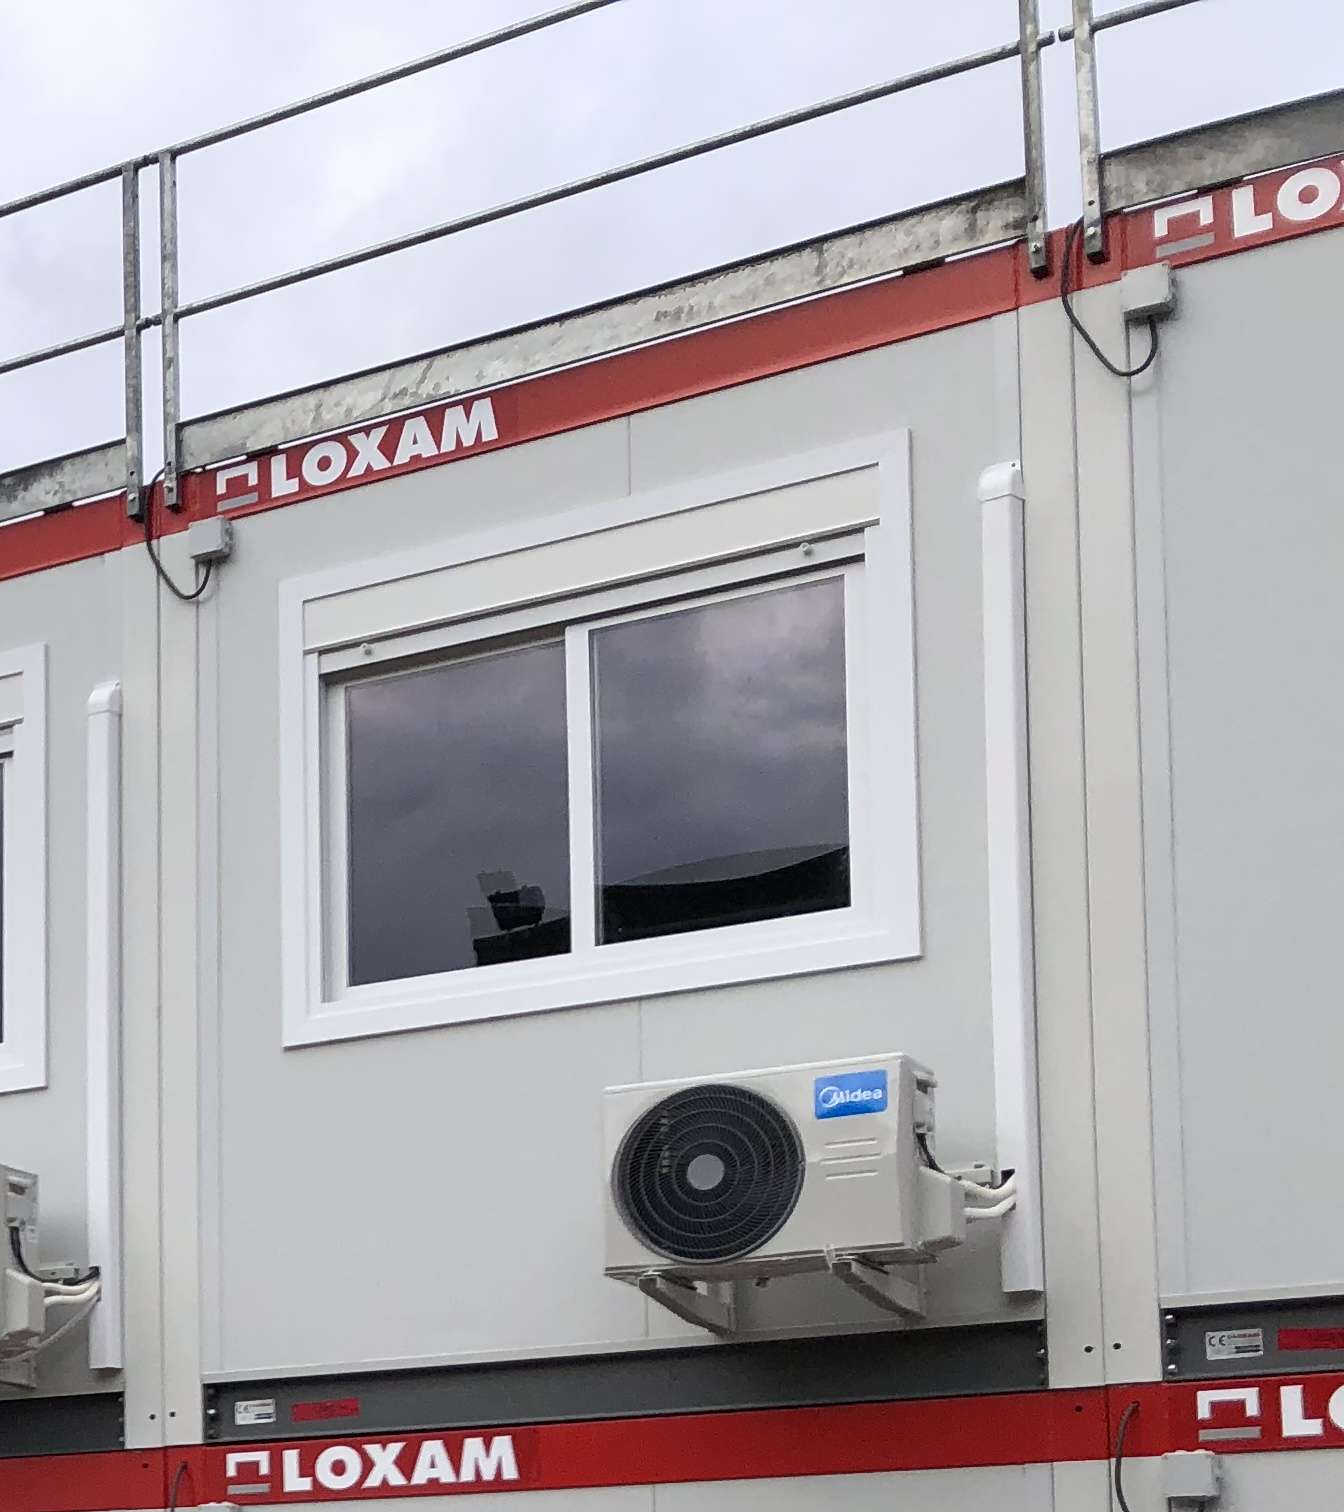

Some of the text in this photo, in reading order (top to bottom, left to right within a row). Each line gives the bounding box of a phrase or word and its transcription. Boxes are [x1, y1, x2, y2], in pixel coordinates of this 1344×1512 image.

[271, 397, 499, 498] LOXAM
[819, 1086, 883, 1108] Midea
[283, 1435, 520, 1493] LOXAM
